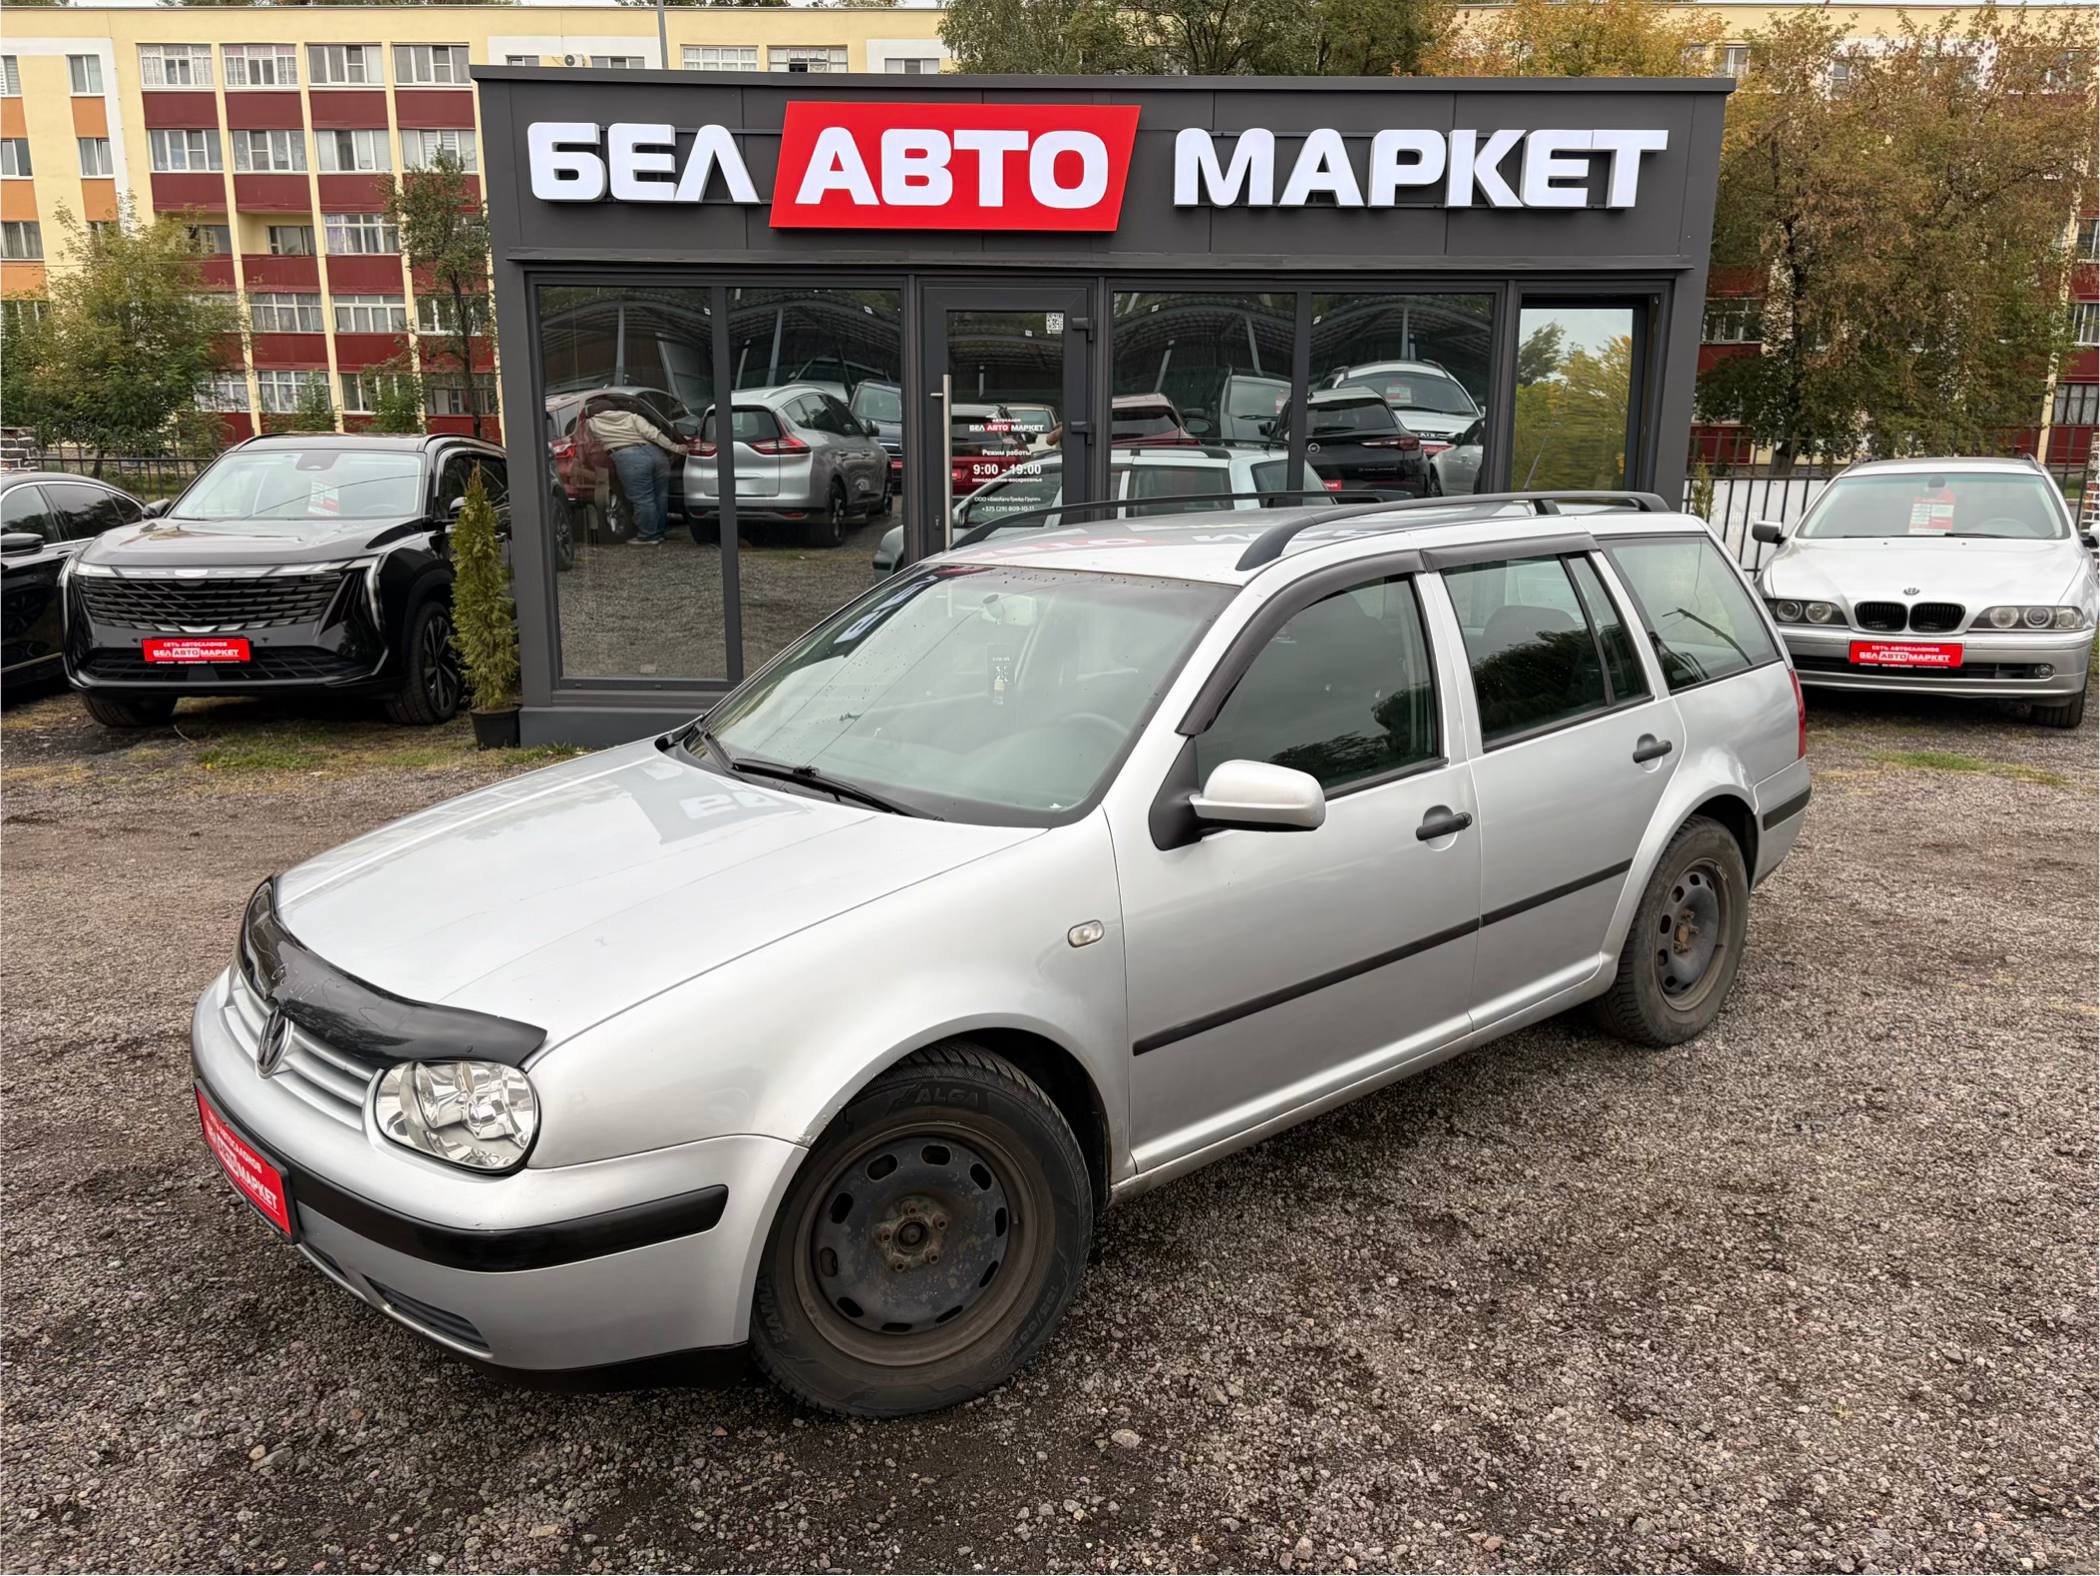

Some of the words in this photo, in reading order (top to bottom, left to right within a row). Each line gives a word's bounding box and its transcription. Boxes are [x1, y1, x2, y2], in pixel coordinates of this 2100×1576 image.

[527, 121, 760, 203] БЕЛ
[795, 127, 1109, 209] АВТО
[1174, 127, 1669, 209] МАРКЕТ
[987, 424, 1010, 432] АВТО
[1011, 424, 1044, 432] МАРКЕТ
[973, 464, 999, 475] 9:00
[1010, 464, 1041, 475] 19:00
[174, 649, 199, 657] АВТО
[200, 649, 239, 658] МАРКЕТ
[1909, 654, 1951, 662] МАРКЕТ
[236, 1160, 278, 1210] МАРКЕТ
